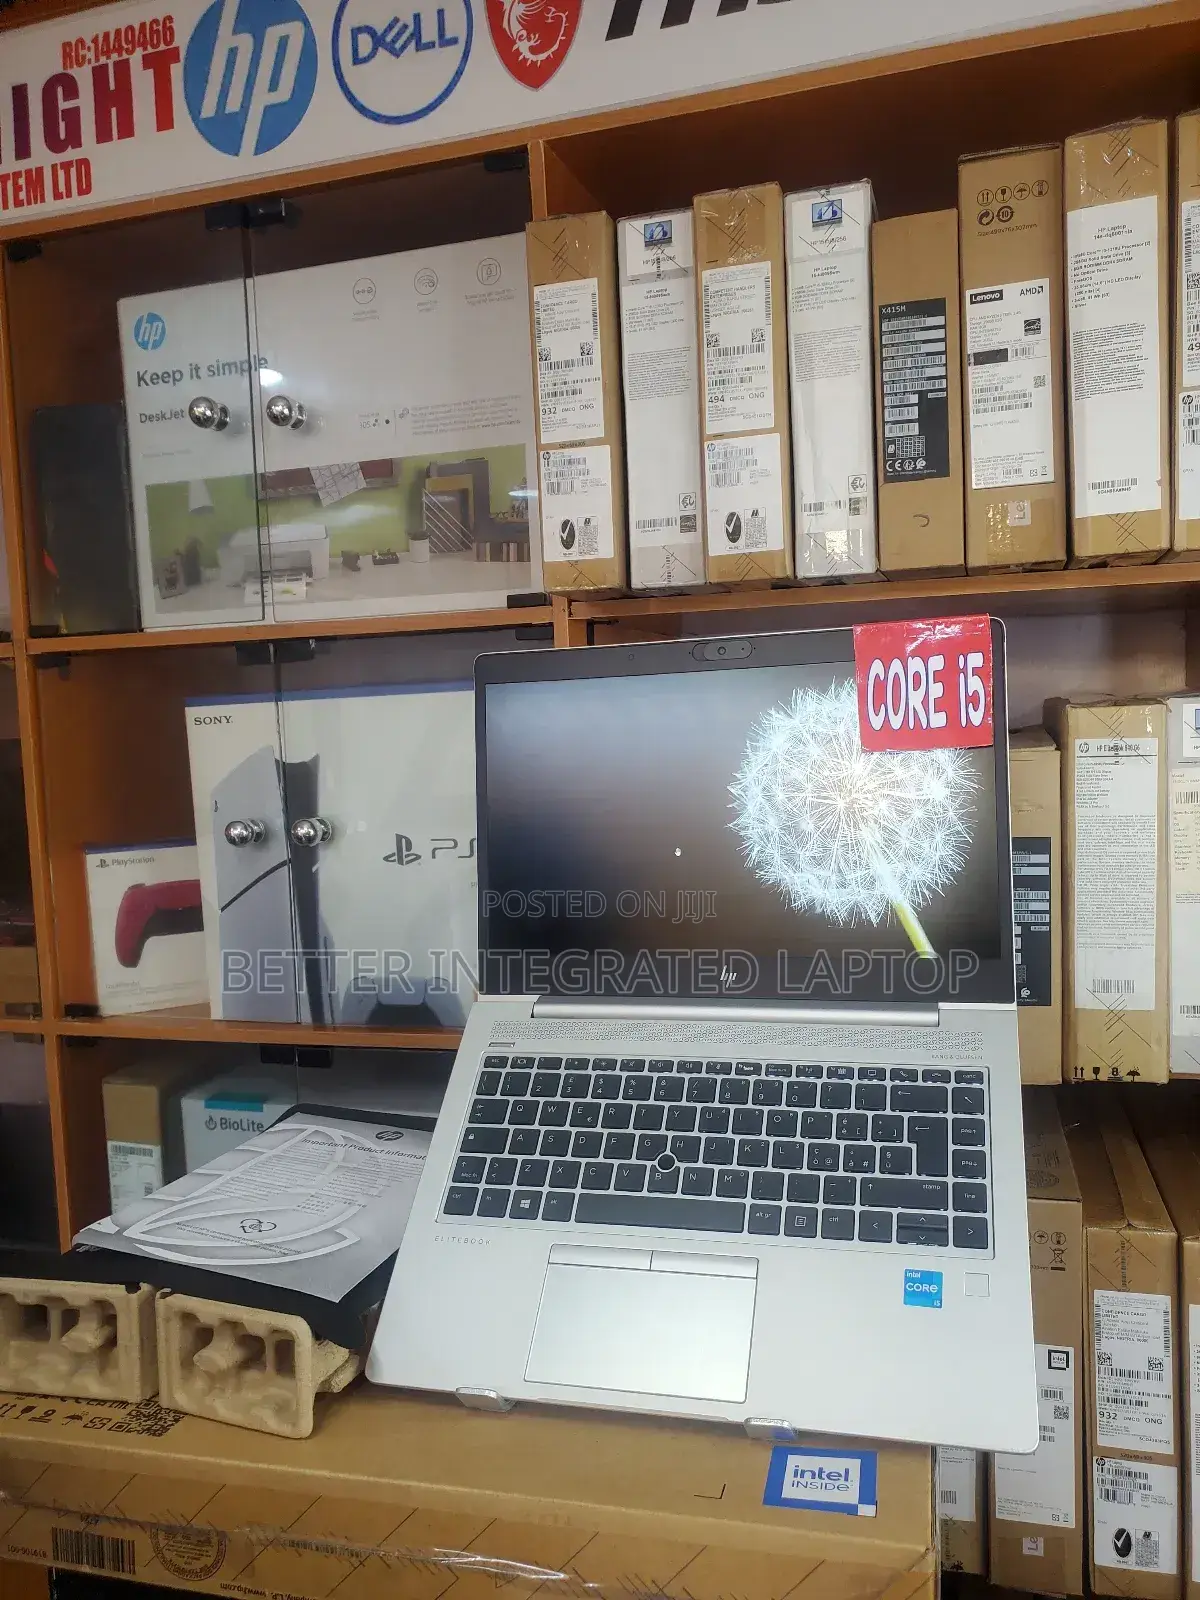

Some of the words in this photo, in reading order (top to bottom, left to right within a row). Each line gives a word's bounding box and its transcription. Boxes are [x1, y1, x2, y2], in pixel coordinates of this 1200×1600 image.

[61, 15, 175, 71] RC:1449466
[350, 9, 459, 66] DELL
[51, 157, 93, 202] LTD
[972, 292, 1001, 302] Lenovo
[1019, 287, 1037, 296] AMD
[134, 312, 166, 350] hp
[136, 368, 184, 387] Keep
[189, 363, 201, 381] it
[207, 354, 269, 378] simple
[708, 395, 725, 403] 494
[139, 409, 185, 424] DeskJet
[541, 406, 557, 415] 932
[867, 653, 948, 732] CORE
[957, 651, 986, 728] i5
[193, 715, 233, 726] SONY
[111, 855, 155, 868] PlayStation
[219, 1117, 264, 1133] BioLite
[302, 1138, 348, 1149] Important
[348, 1143, 384, 1154] Product
[434, 1235, 491, 1246] ELITEBOOK
[906, 1270, 921, 1278] intel
[1098, 1410, 1118, 1421] 932
[1144, 1417, 1163, 1425] ONG
[793, 1465, 850, 1482] intel
